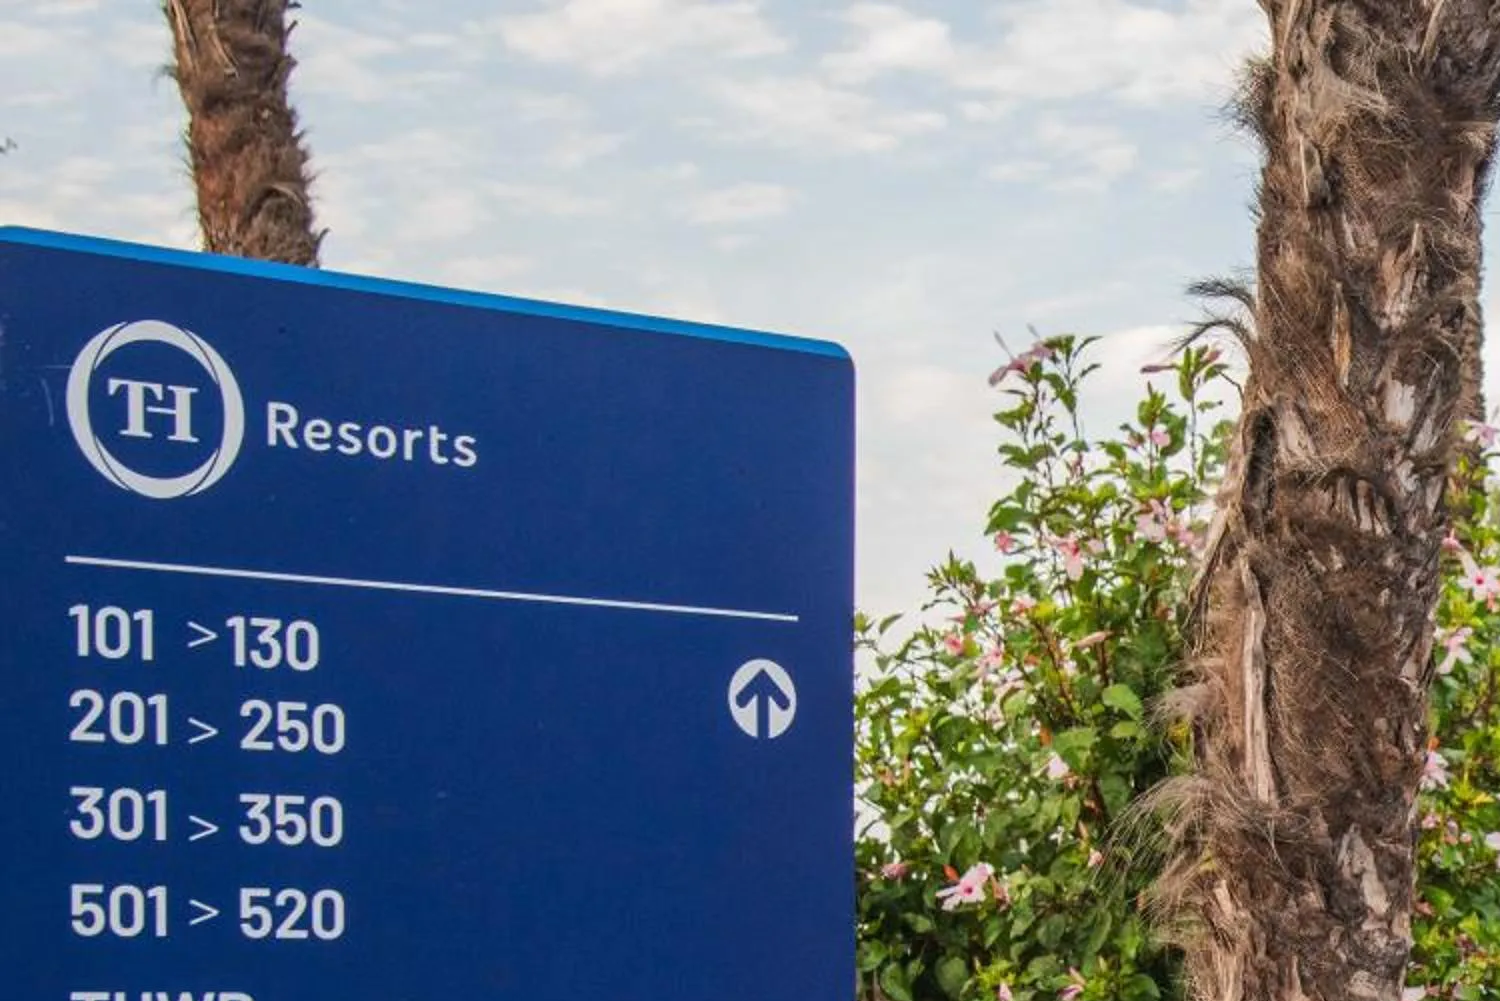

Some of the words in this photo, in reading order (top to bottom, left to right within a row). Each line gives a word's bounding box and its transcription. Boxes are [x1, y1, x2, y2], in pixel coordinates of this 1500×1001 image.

[109, 379, 198, 442] TH
[268, 402, 476, 466] Resorts
[70, 605, 153, 660] 101
[70, 690, 167, 744] 201
[240, 700, 345, 753] 250
[70, 787, 167, 840] 301
[239, 794, 343, 847] 350
[71, 885, 167, 937] 501
[240, 888, 345, 940] 520
